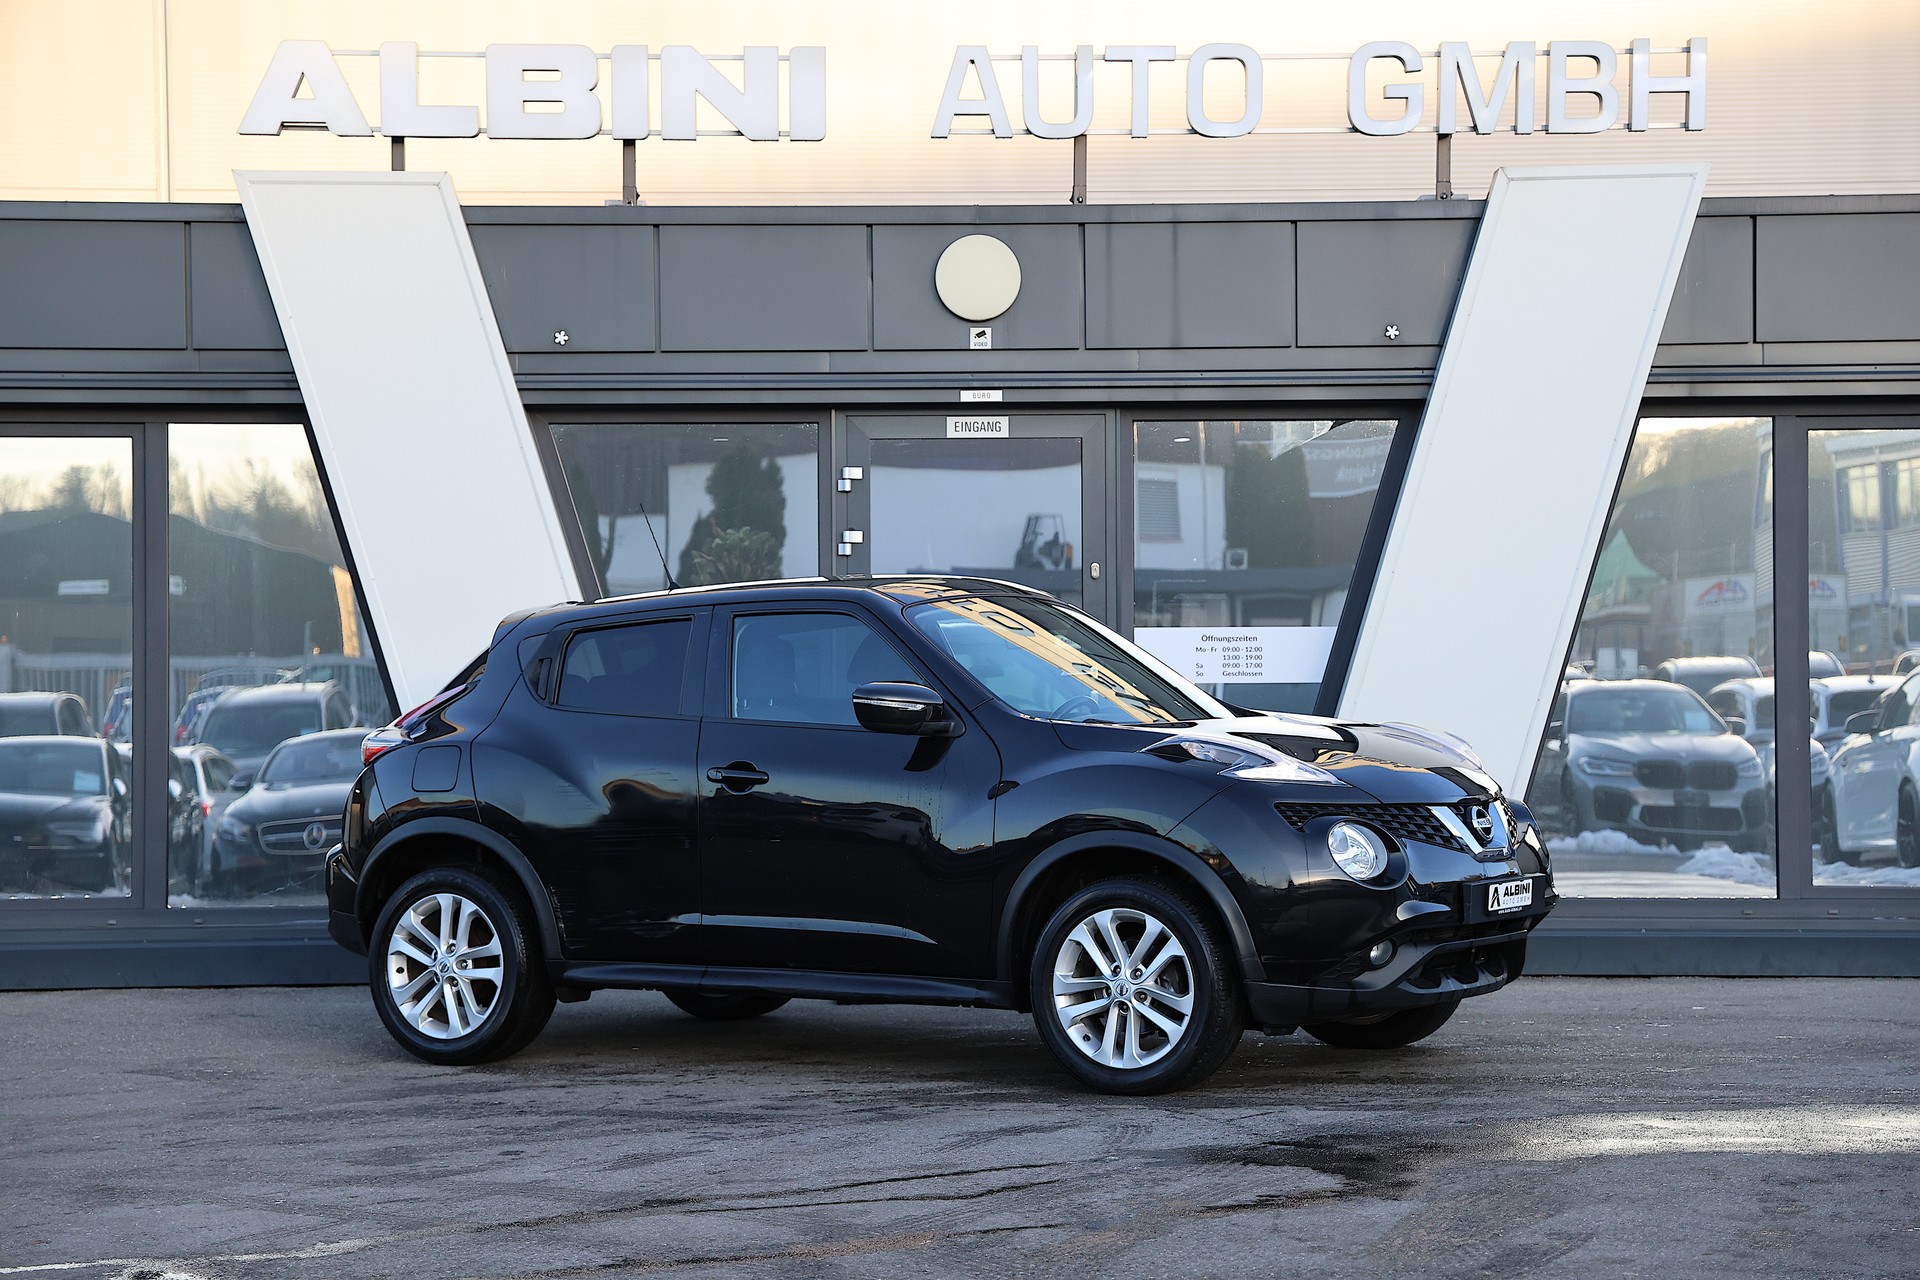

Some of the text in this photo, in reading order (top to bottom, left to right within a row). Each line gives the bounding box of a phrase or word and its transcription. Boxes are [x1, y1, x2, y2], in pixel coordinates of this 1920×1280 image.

[238, 36, 1708, 142] ALBINI AUTO GMBH
[972, 391, 991, 399] BÜRO
[954, 421, 1002, 433] EINGANG
[1201, 634, 1258, 643] Öffnungszeiten
[1503, 883, 1530, 897] ALBINI
